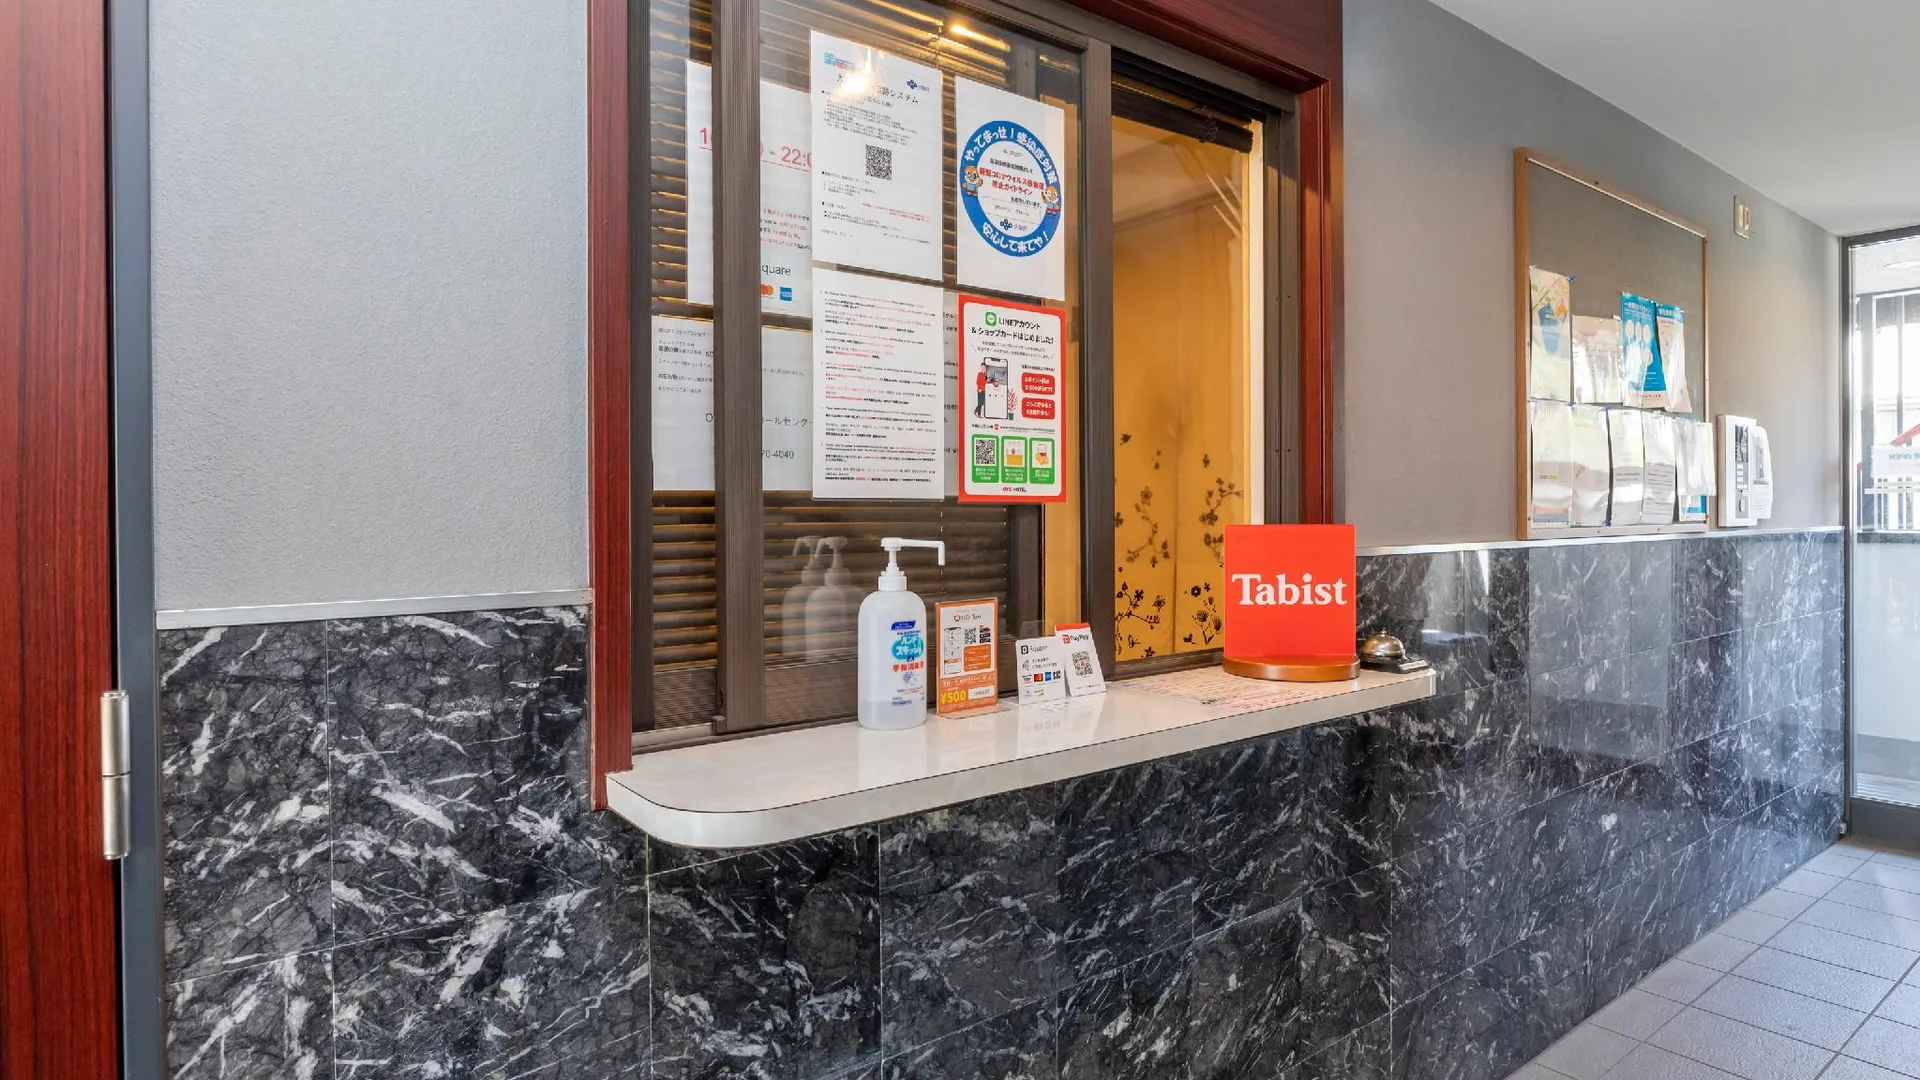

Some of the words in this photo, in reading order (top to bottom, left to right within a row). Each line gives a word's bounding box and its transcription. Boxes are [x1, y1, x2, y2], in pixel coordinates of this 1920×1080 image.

[761, 264, 792, 276] quare
[1231, 572, 1348, 606] Tabist
[940, 690, 967, 705] ¥500
